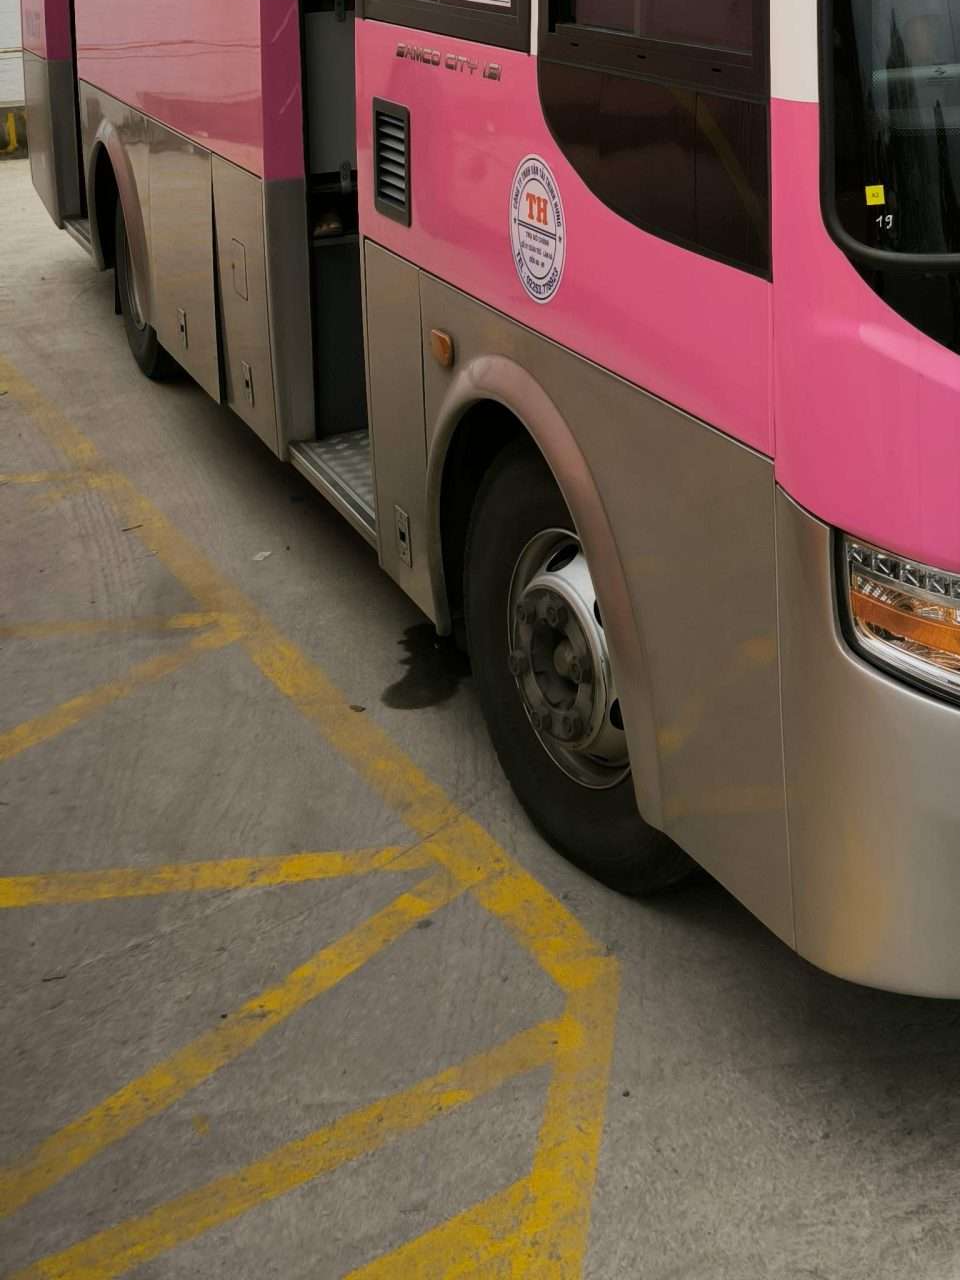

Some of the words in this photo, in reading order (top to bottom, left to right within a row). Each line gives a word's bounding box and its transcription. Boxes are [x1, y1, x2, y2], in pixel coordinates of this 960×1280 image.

[396, 42, 441, 67] SAMCO
[445, 52, 478, 75] CITY
[525, 191, 548, 226] TH
[875, 214, 894, 230] 19
